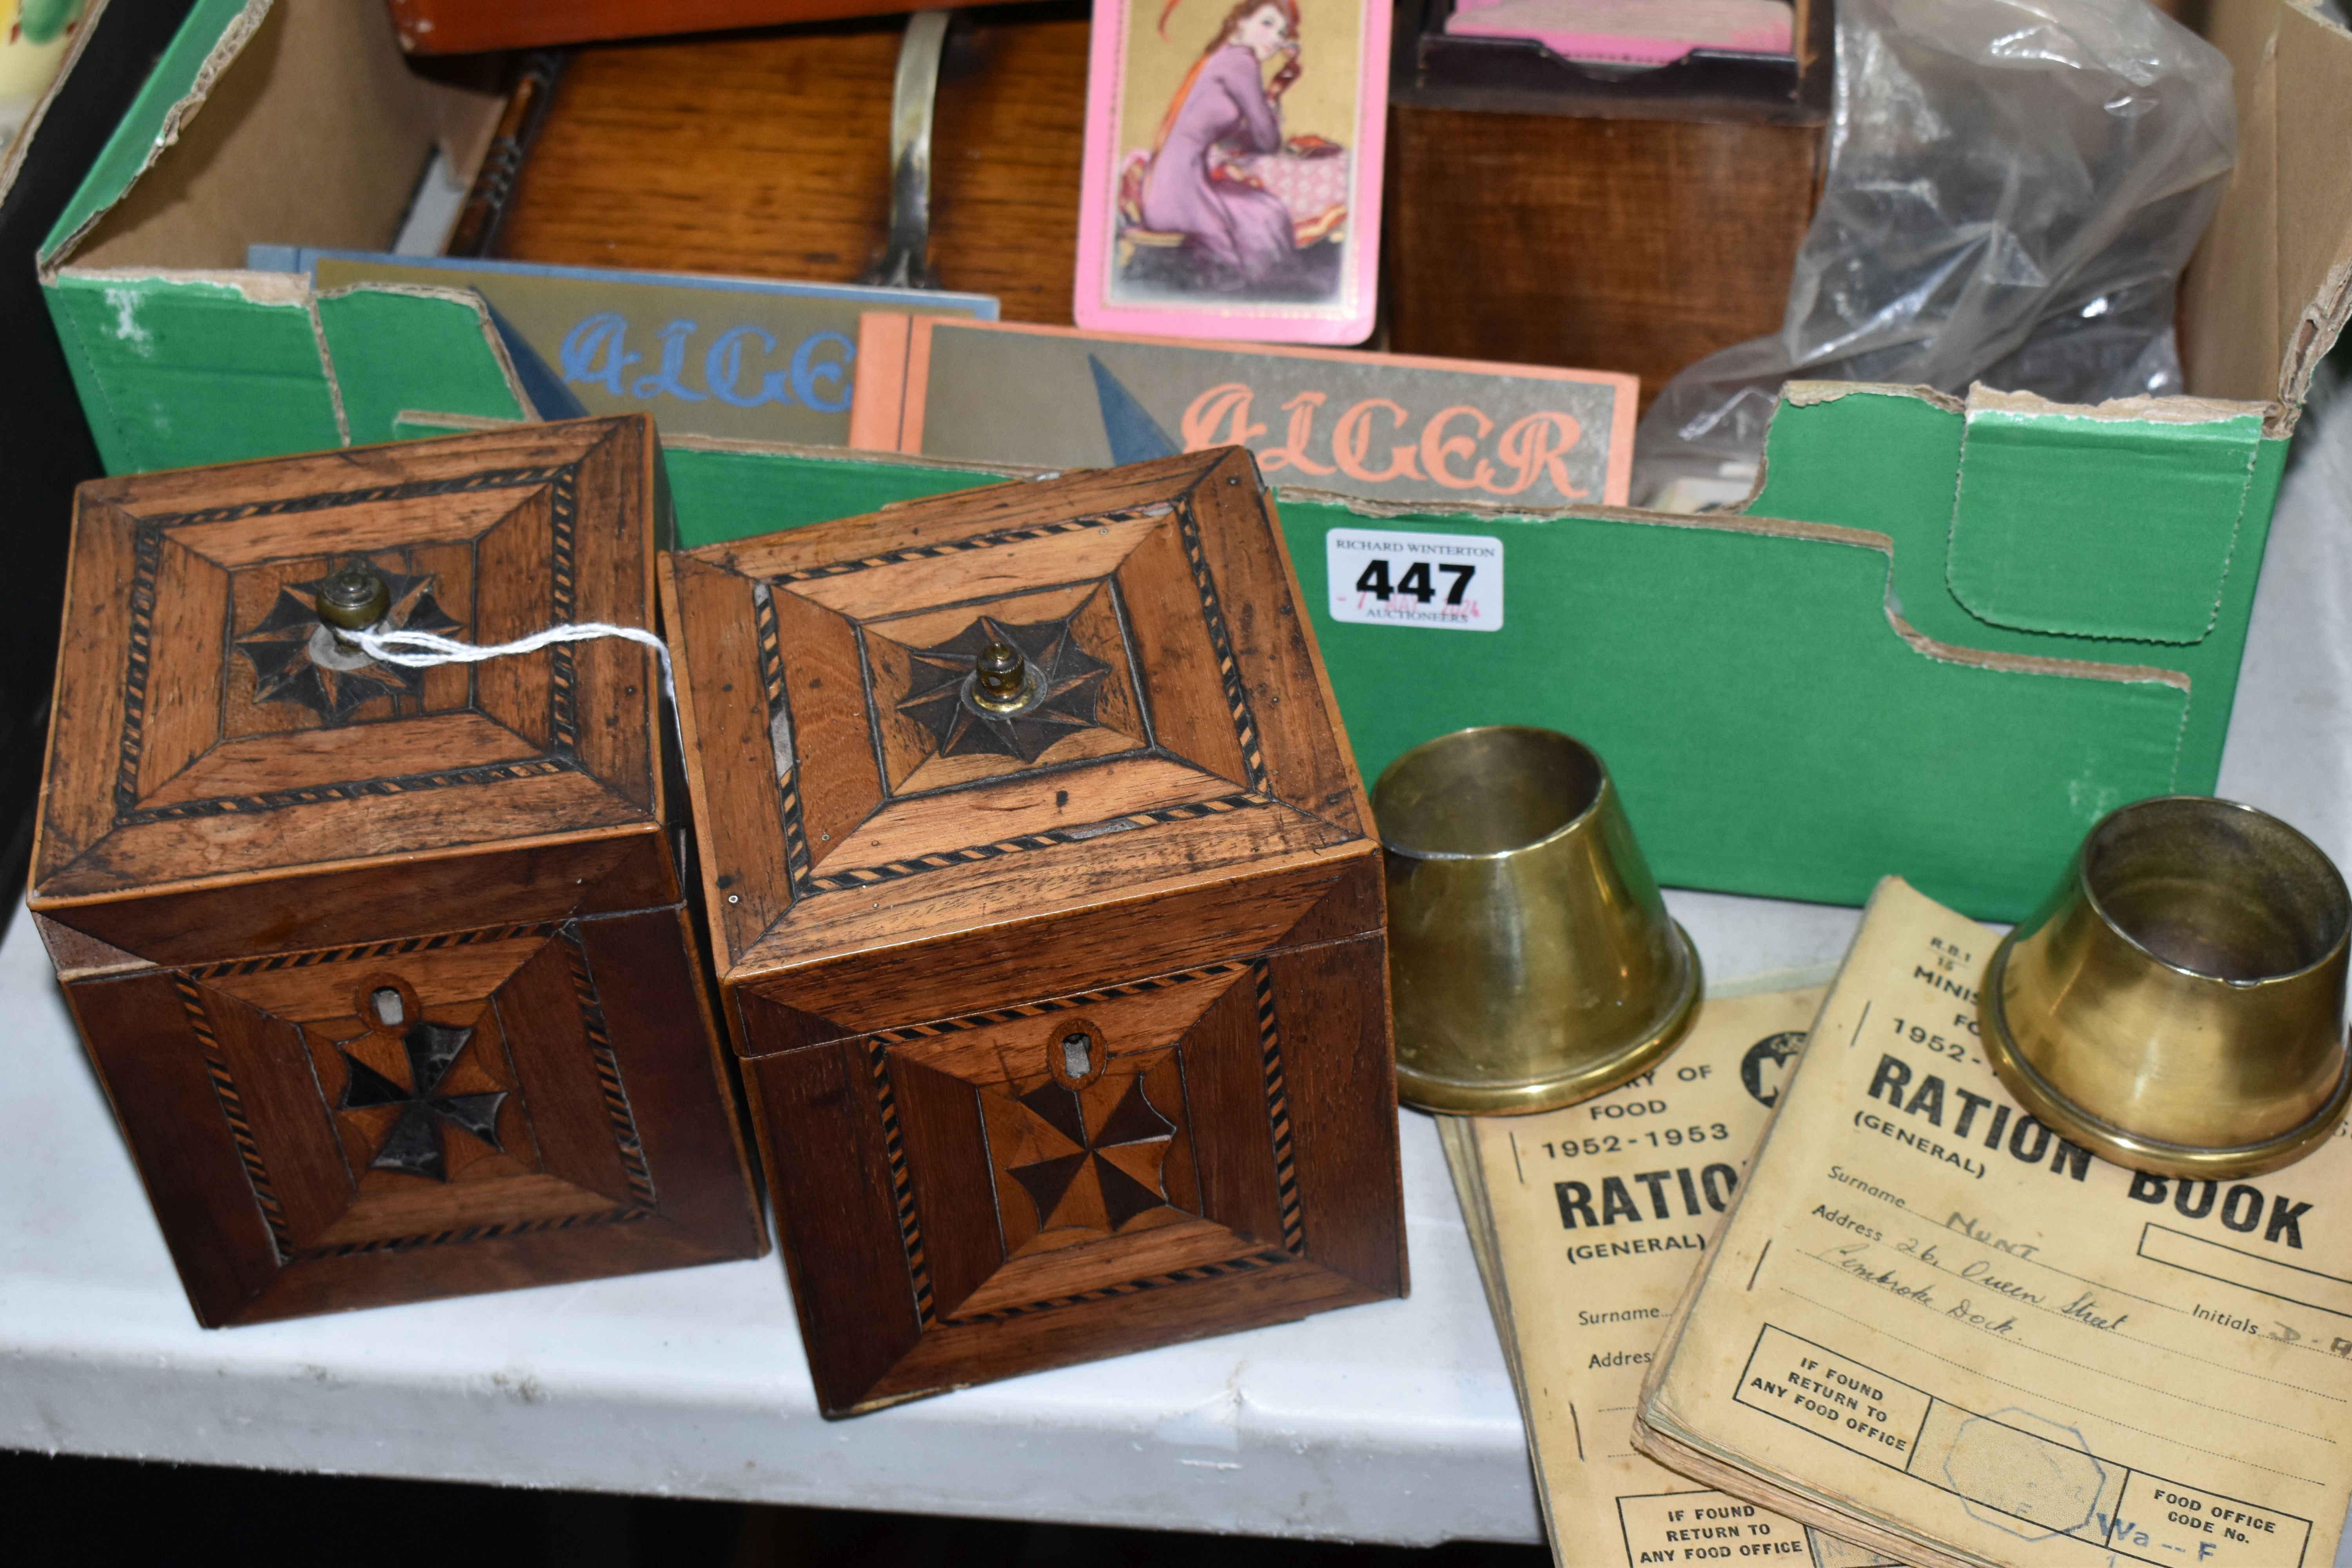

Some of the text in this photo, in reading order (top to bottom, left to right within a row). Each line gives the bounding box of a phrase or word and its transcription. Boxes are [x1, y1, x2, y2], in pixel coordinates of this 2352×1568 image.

[1180, 383, 1589, 499] ALGER
[1336, 539, 1495, 557] RICHARD WINTERTON
[1356, 559, 1475, 605] 447
[1366, 609, 1468, 623] AUCTIONEERS
[1677, 1065, 1712, 1082] OF
[1590, 1100, 1667, 1120] FOOD
[1853, 1110, 1986, 1180] (GENERAL)
[1868, 1053, 2314, 1249] RATION BOOK
[1828, 1165, 1906, 1209] Surname
[1811, 1204, 1883, 1242] Address
[1566, 1234, 1706, 1264] (GENERAL)
[1578, 1306, 1659, 1326] Surname
[2192, 1304, 2259, 1335] Initials
[1588, 1352, 1653, 1369] Addres
[1800, 1357, 1883, 1401] IF FOUND
[1788, 1372, 1887, 1422] RETURN TO
[1750, 1377, 1907, 1451] ANY FOOD OFFICE
[1668, 1505, 1756, 1523] IF FOUND
[2154, 1489, 2276, 1534] FOOD OFFICE
[2168, 1511, 2250, 1544] CODE No.
[1666, 1523, 1771, 1542] RETURN TO
[2096, 1512, 2149, 1548] Wa
[2198, 1541, 2217, 1563] F
[1640, 1540, 1803, 1564] ANY FOOD OFFICE
